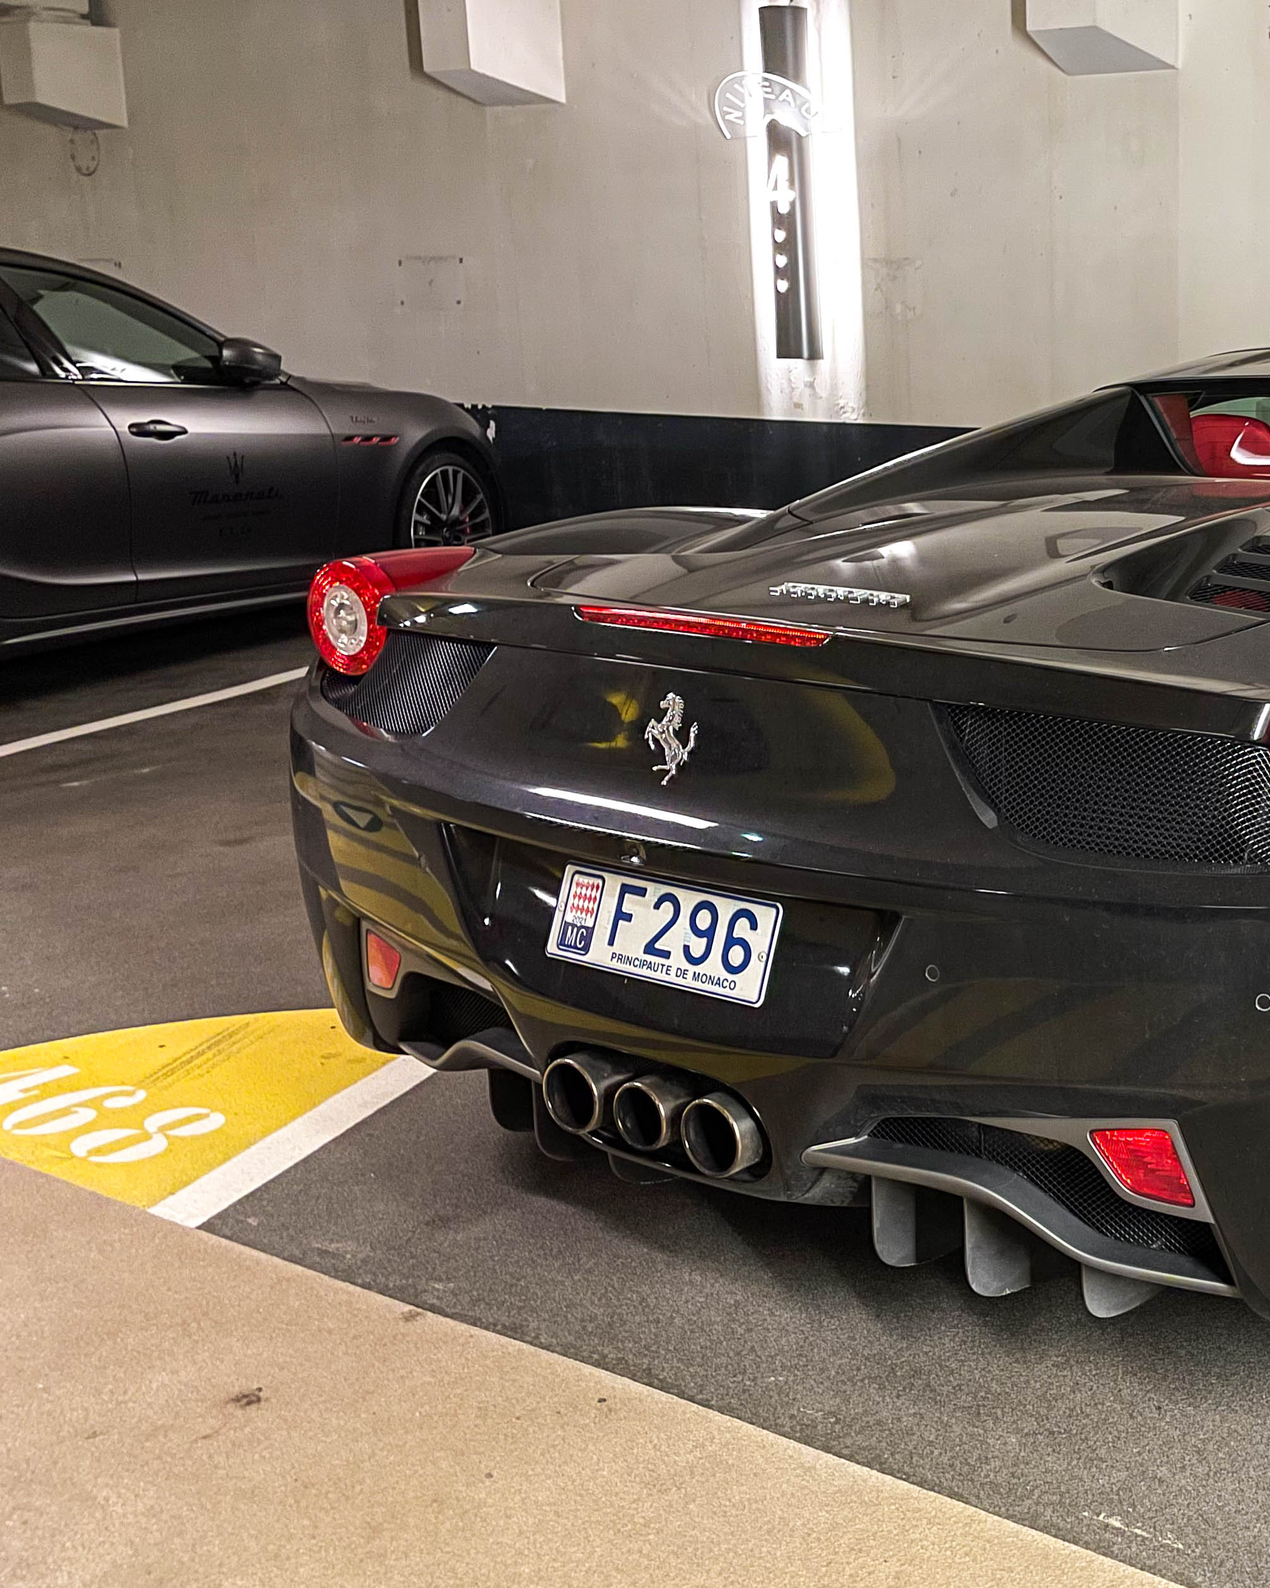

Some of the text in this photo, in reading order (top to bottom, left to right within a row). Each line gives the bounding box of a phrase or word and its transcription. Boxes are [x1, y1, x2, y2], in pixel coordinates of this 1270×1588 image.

[722, 77, 818, 125] NIVEAU
[766, 153, 796, 214] 4
[565, 925, 586, 948] MC
[572, 915, 587, 925] 2021
[607, 883, 758, 975] F296
[610, 952, 737, 991] PRINCIPAUTE DE MONACO
[0, 1064, 226, 1163] 468
